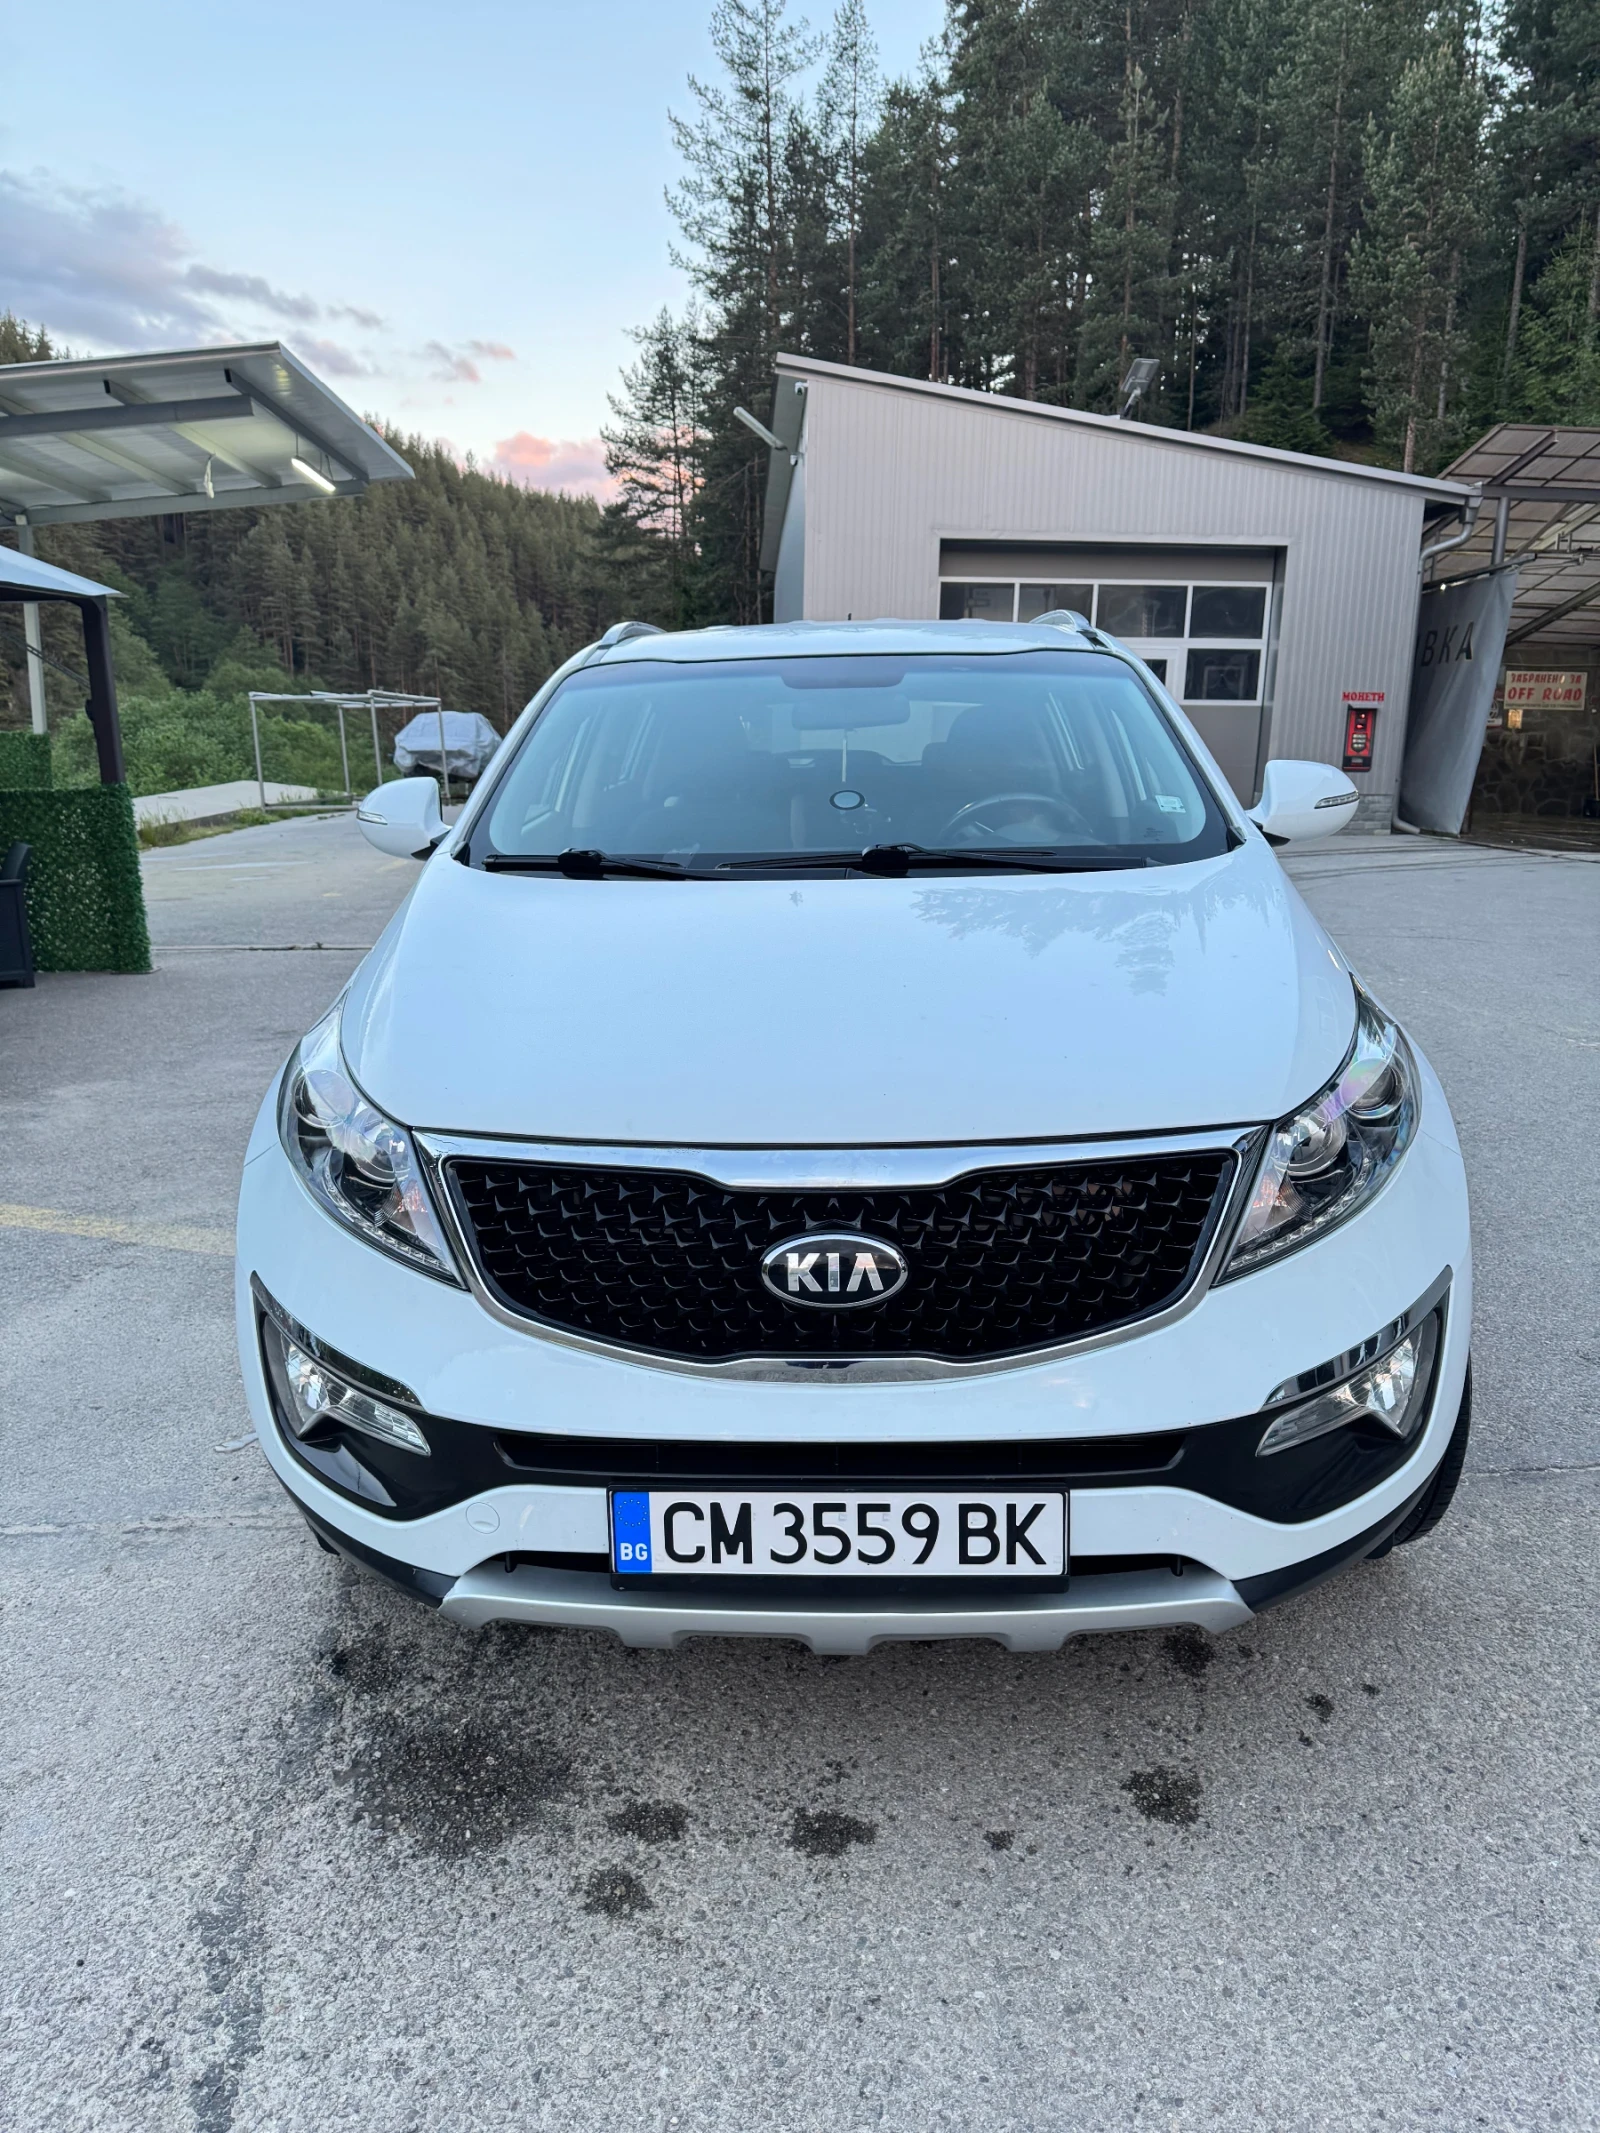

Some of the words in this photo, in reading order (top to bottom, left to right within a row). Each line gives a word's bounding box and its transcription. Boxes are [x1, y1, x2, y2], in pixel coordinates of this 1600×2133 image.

[1416, 621, 1475, 670] ВКА
[1570, 674, 1582, 684] ЗА
[1342, 692, 1385, 702] МОНЕТИ
[1508, 687, 1535, 700] OFF
[1542, 687, 1582, 701] ROAD
[786, 1252, 885, 1292] KIA
[663, 1501, 753, 1565] CM
[770, 1502, 940, 1565] 3559
[958, 1502, 1047, 1565] BK
[620, 1543, 648, 1561] BG
